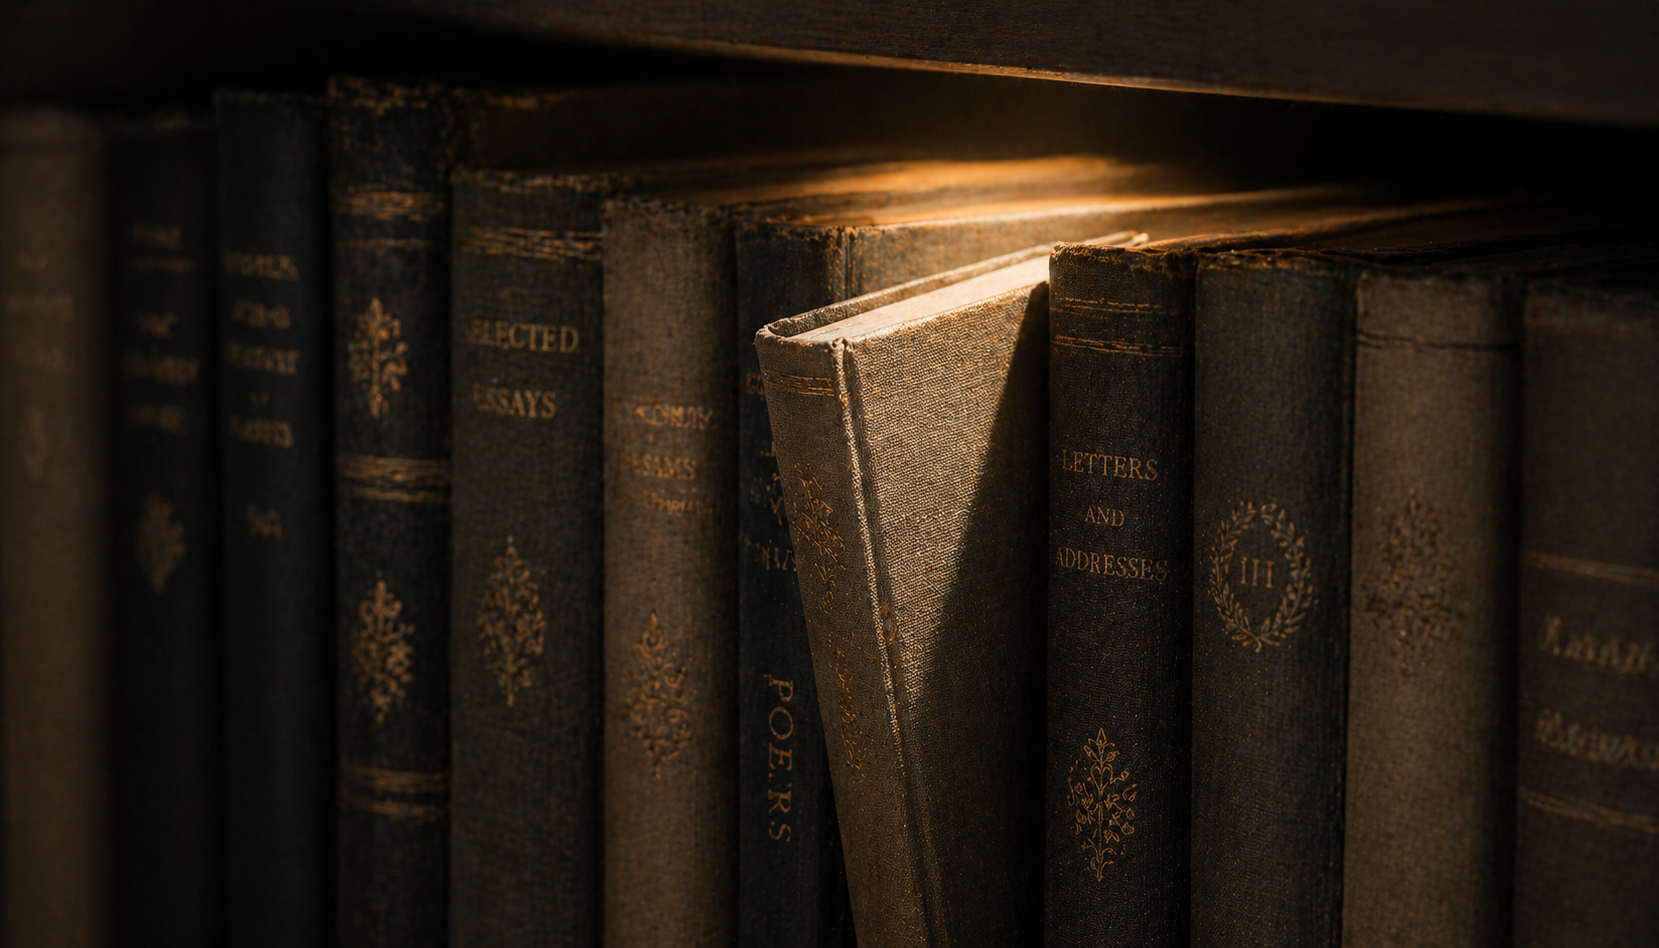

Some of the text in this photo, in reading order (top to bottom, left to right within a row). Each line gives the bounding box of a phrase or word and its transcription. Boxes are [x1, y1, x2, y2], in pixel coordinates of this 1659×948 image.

[1062, 449, 1159, 482] LETTERS
[1084, 506, 1126, 528] AND
[1055, 546, 1169, 582] ADDRESSES
[1240, 556, 1275, 589] III
